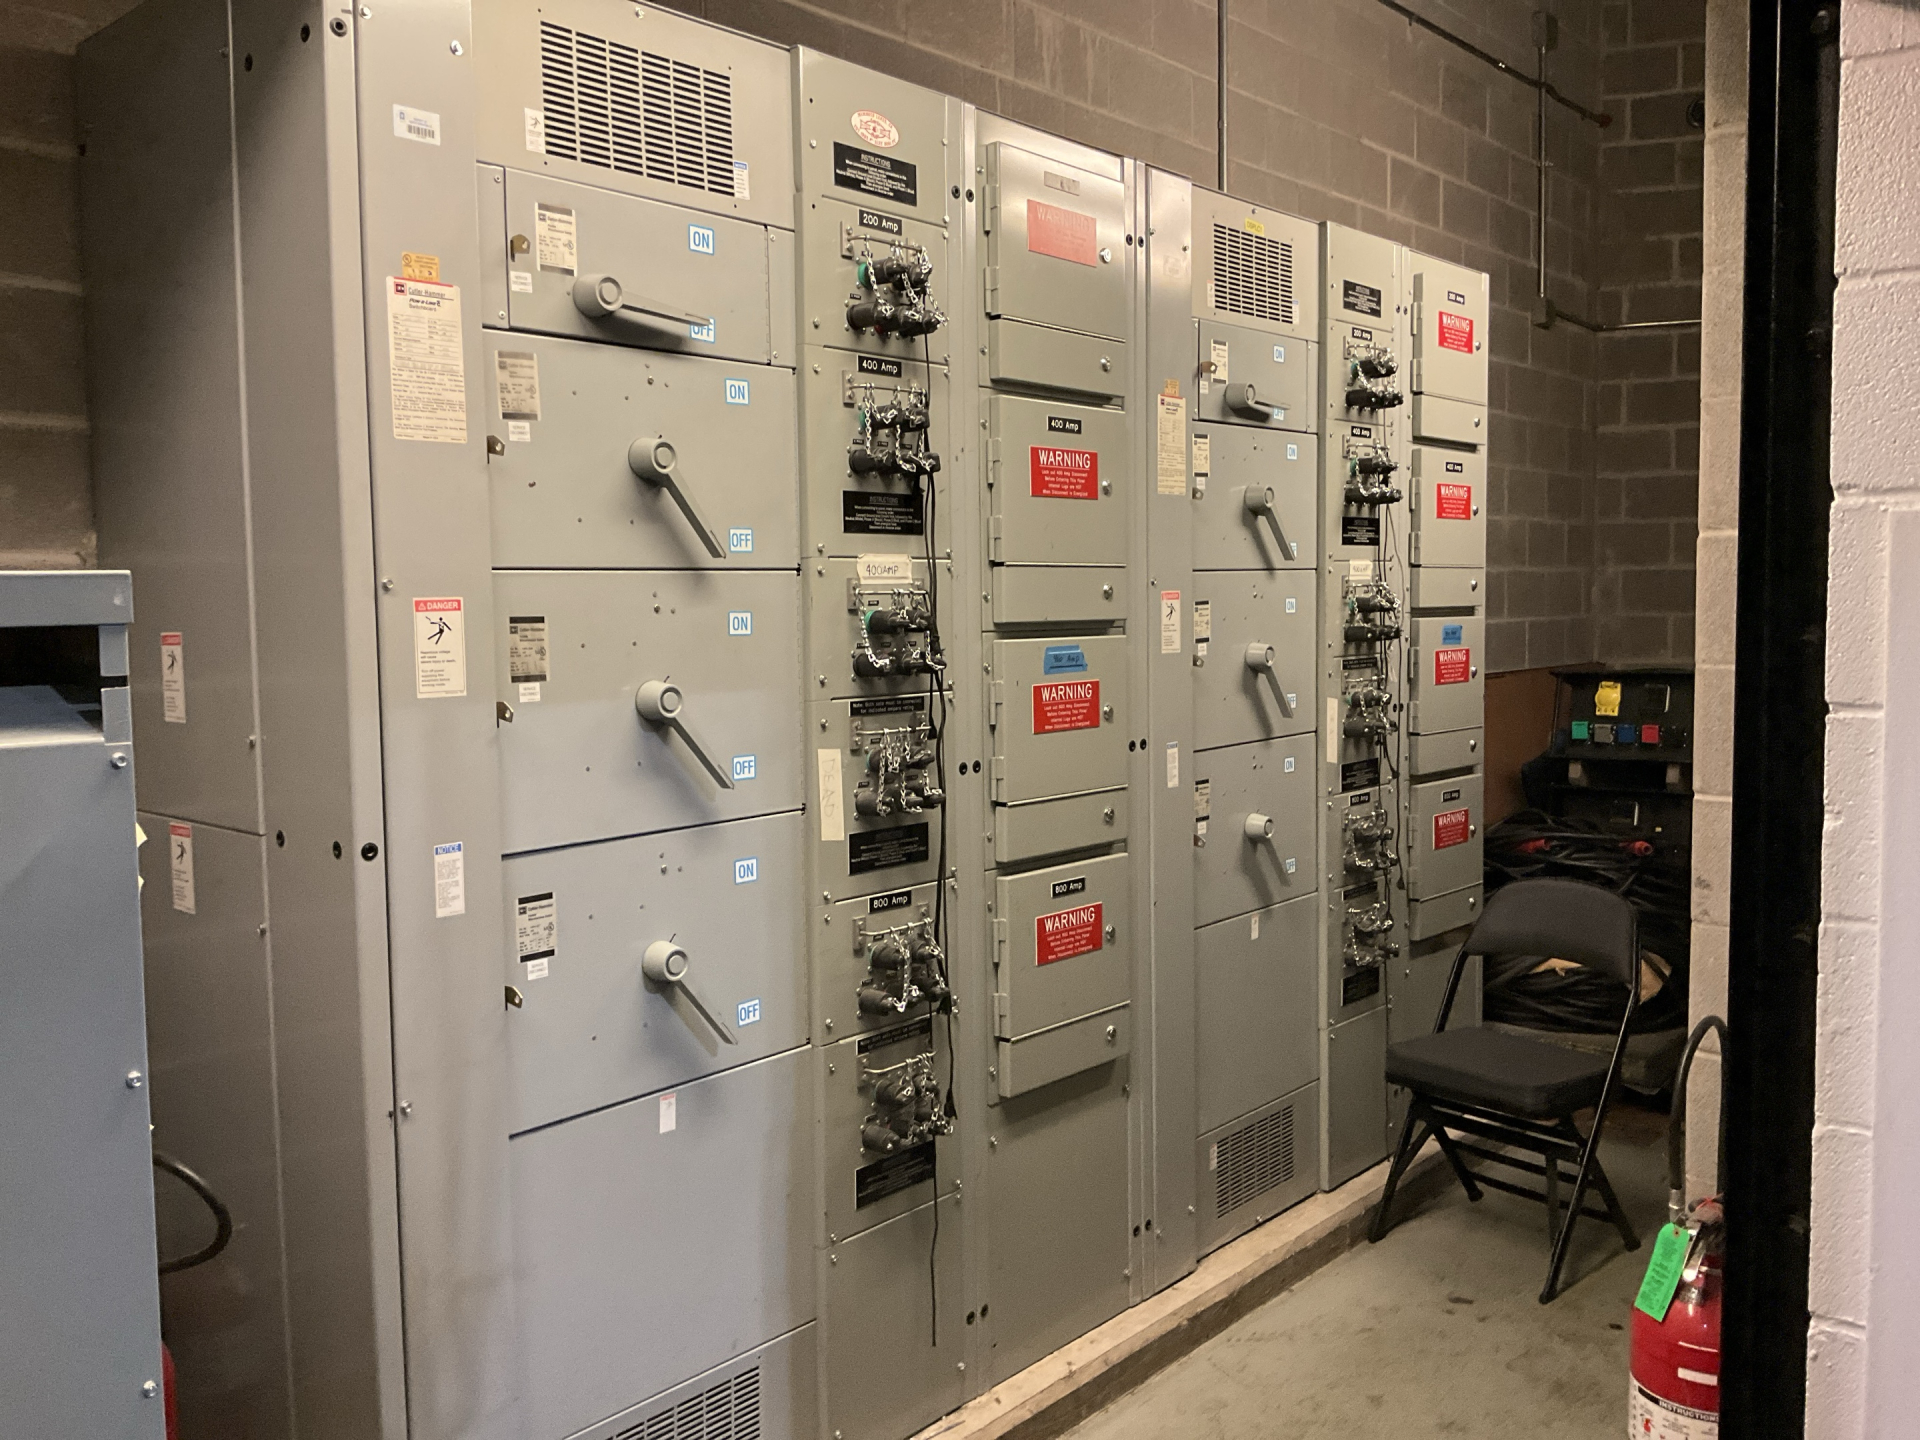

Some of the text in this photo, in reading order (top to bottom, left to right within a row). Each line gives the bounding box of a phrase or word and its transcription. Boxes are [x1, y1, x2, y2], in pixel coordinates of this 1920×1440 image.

[863, 213, 898, 232] 200 Amp
[693, 231, 710, 249] ON
[1442, 313, 1470, 332] WARNING
[862, 361, 898, 374] 400 Amp
[730, 384, 745, 400] ON
[1051, 419, 1079, 432] 400 Amp
[1038, 449, 1091, 468] WARNING
[1440, 485, 1468, 498] WARNING
[732, 532, 751, 548] OFF
[427, 601, 459, 610] DANGER
[732, 616, 748, 631] ON
[1438, 650, 1467, 662] WARNING
[1041, 683, 1092, 702] WARNING
[734, 759, 754, 776] OFF
[821, 758, 836, 818] DEAD
[1438, 811, 1466, 827] WARNING
[438, 844, 459, 855] NOTICE
[738, 863, 753, 879] ON
[1055, 882, 1082, 893] 800 Amp
[873, 895, 908, 908] 800 Amp
[1044, 907, 1095, 933] WARNING
[739, 1005, 759, 1022] OFF
